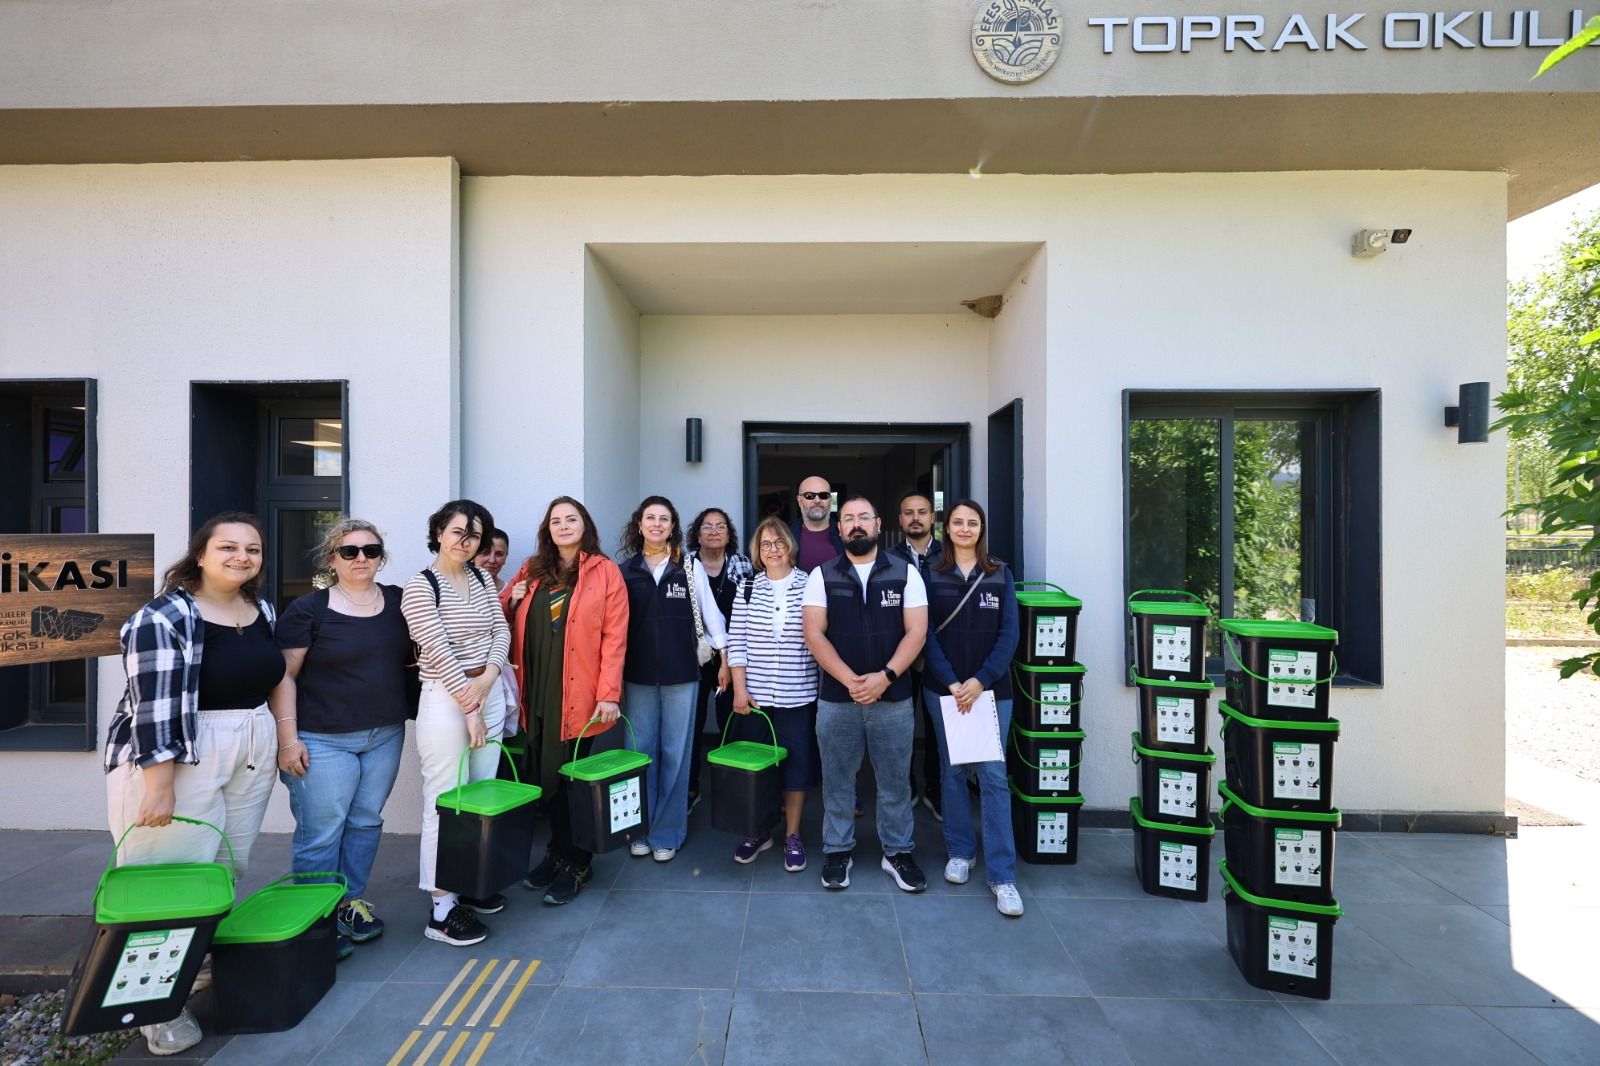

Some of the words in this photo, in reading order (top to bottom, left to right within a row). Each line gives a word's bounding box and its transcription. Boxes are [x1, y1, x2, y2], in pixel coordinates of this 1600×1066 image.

[980, 2, 1002, 32] EFES
[1087, 12, 1369, 53] TOPRAK
[1, 552, 128, 594] İKASI
